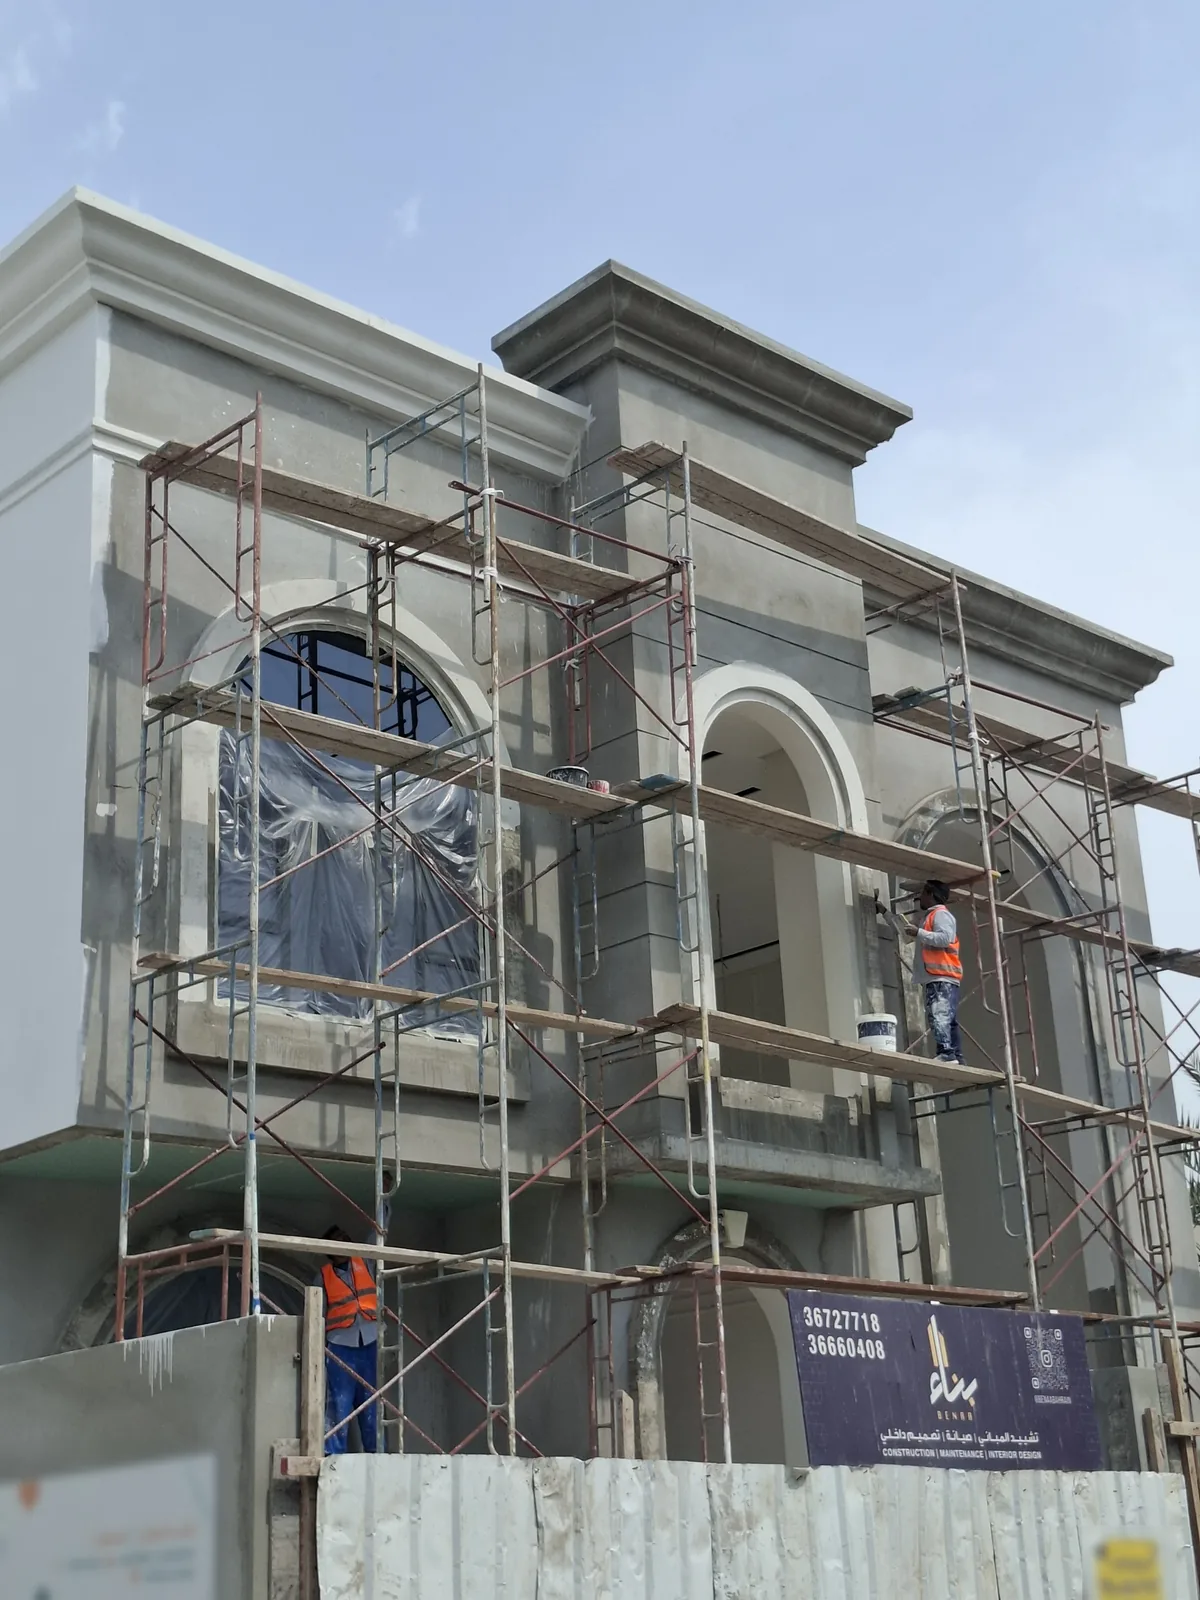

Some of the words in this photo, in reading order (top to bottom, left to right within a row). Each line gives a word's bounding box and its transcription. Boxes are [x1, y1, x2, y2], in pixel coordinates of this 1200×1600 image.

[803, 1306, 880, 1333] 36727718
[807, 1334, 886, 1360] 36660408
[880, 1428, 907, 1445] داخلي
[907, 1429, 940, 1443] تصميم
[946, 1429, 973, 1444] صيانة
[978, 1431, 1010, 1446] المباني
[1010, 1430, 1039, 1446] تشييد
[882, 1448, 936, 1458] CONSTRUCTION
[939, 1449, 985, 1459] MAINTENANCE
[988, 1450, 1018, 1459] INTERIOR
[1019, 1451, 1042, 1459] DESIGN
